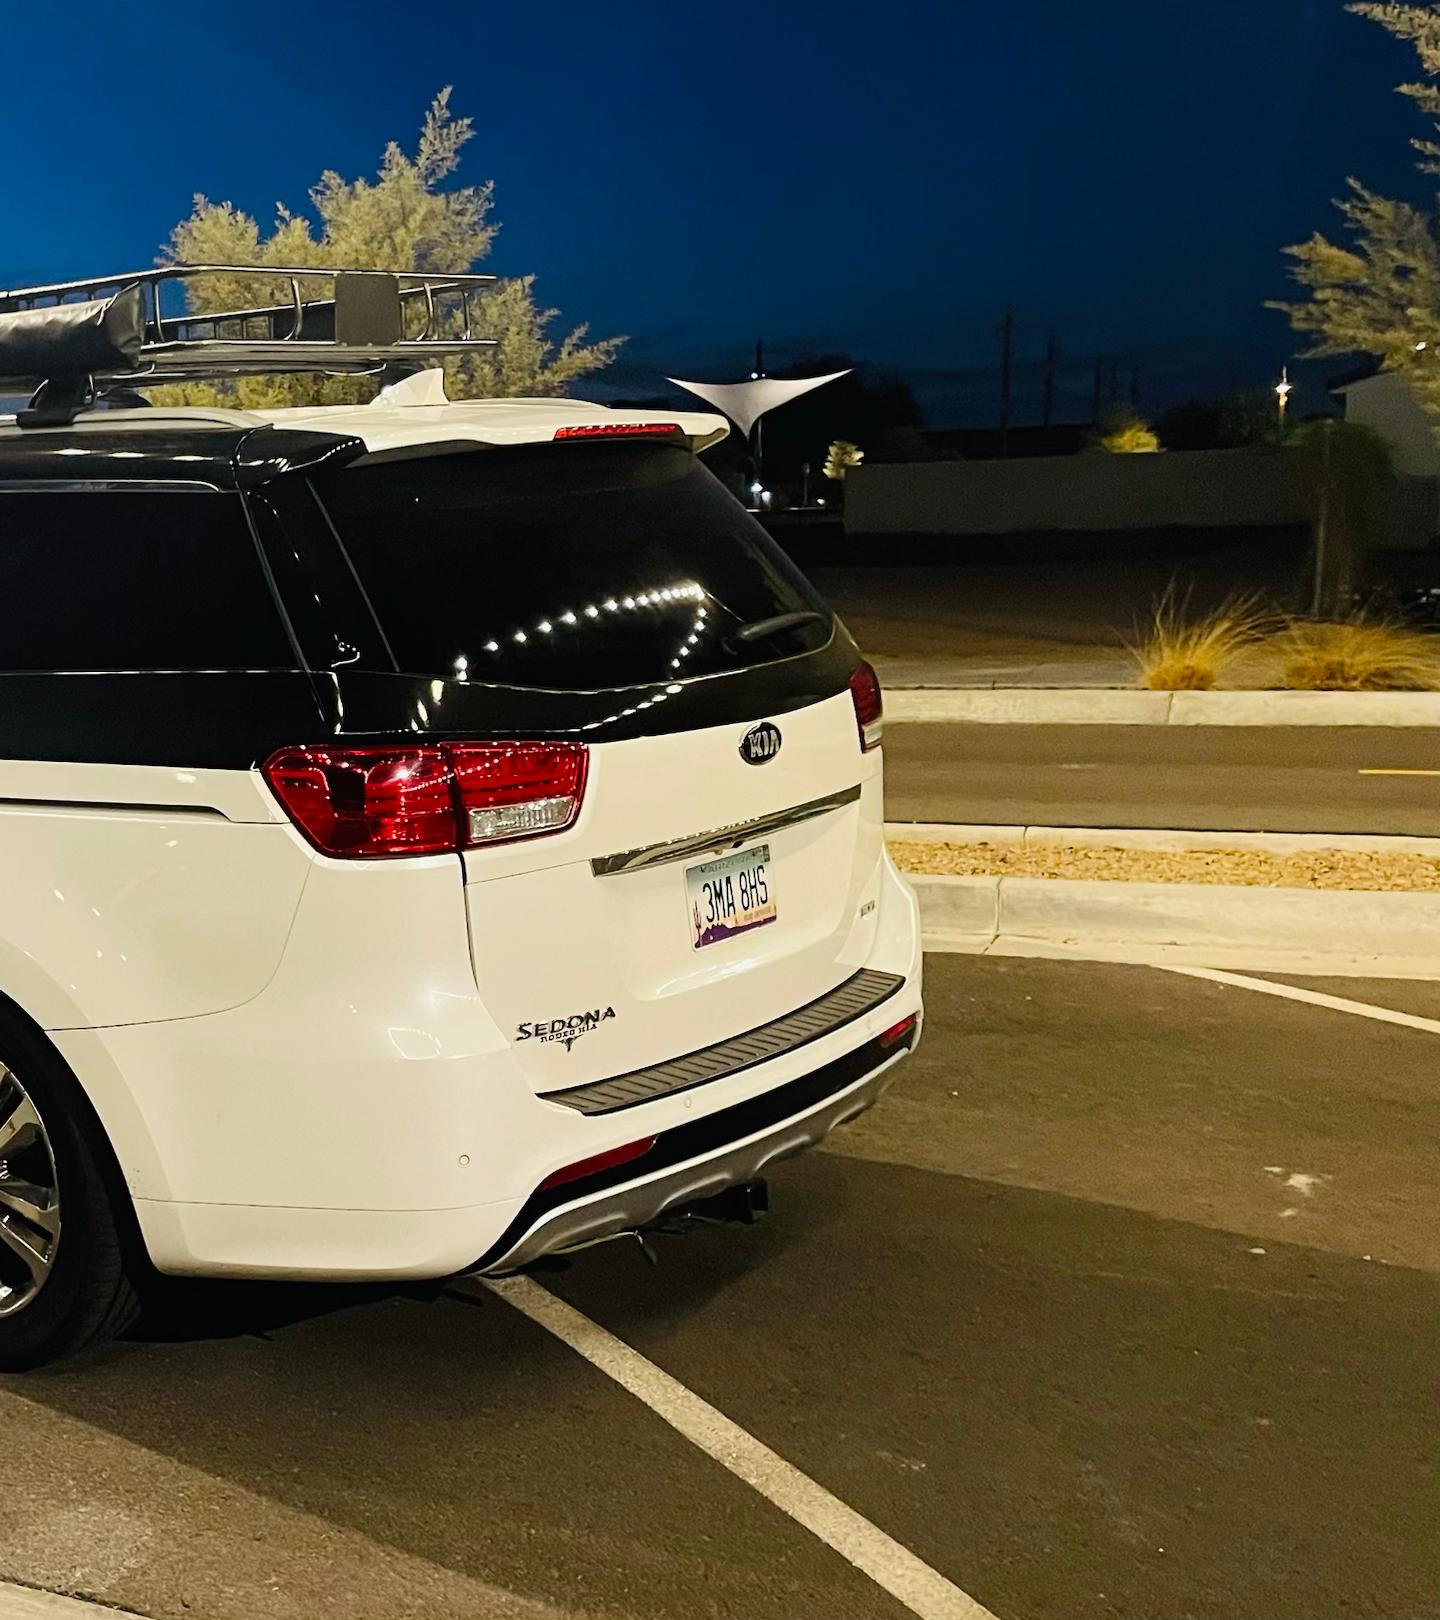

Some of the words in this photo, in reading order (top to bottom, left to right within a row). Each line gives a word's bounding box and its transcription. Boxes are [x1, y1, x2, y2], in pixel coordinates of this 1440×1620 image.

[748, 729, 780, 758] KIA
[702, 875, 736, 923] 3MA
[739, 864, 769, 911] 8HS
[515, 1006, 616, 1041] SEDONA
